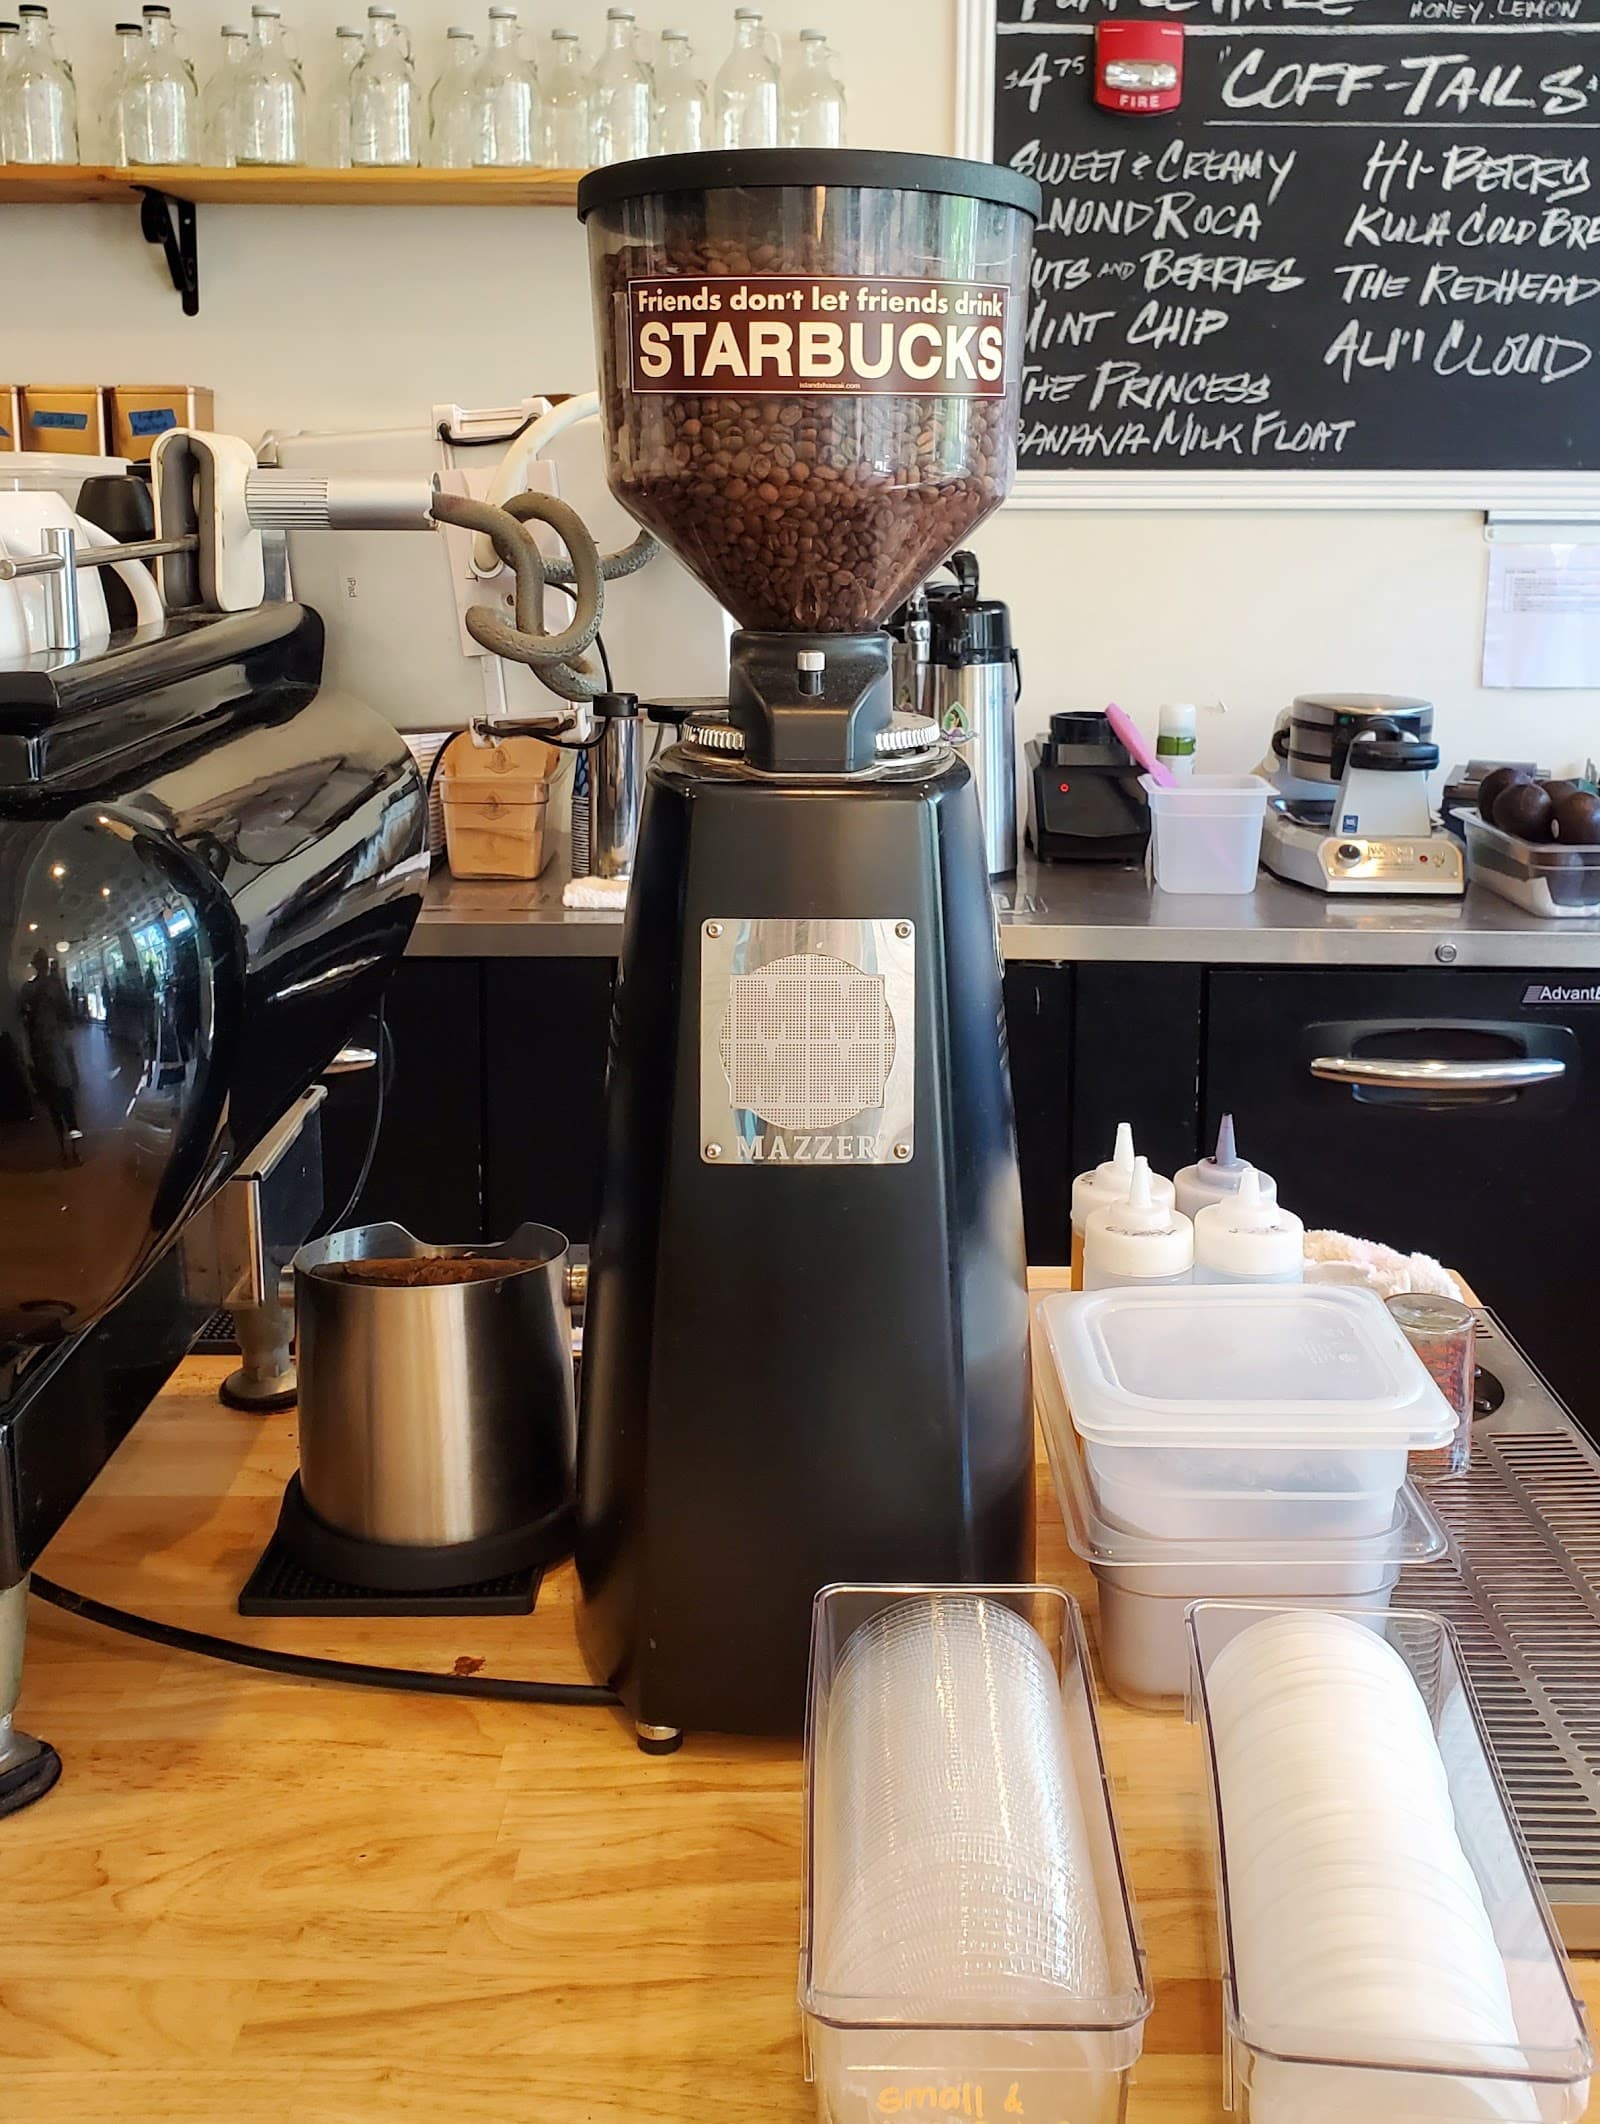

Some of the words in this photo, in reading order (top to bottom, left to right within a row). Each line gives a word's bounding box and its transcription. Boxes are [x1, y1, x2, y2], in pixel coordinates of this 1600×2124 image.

[1499, 0, 1582, 18] LEMON
[1119, 94, 1160, 108] FIRE
[1009, 139, 1127, 185] SWEET
[1131, 151, 1153, 181] &
[1156, 139, 1297, 206] CREAMY
[1035, 196, 1155, 237] MOND
[1152, 191, 1262, 242] ROCA
[1344, 203, 1452, 247] KULA
[1456, 202, 1538, 246] COLD
[1031, 247, 1092, 300] UTS
[1097, 262, 1137, 281] AND
[1139, 247, 1305, 294] BERRIES
[1334, 263, 1411, 304] THE
[1419, 262, 1600, 307] REDHEAD
[638, 288, 722, 313] Friends
[729, 286, 803, 312] don't
[811, 286, 851, 312] let
[856, 287, 949, 315] friends
[954, 289, 1003, 318] drink
[1126, 299, 1230, 350] CHIP
[639, 321, 1003, 382] STARBUCKS
[1433, 319, 1593, 384] CLOUD
[1088, 359, 1272, 412] PRINCESS
[1152, 408, 1245, 457] MILK
[1251, 409, 1357, 456] FLOAT
[736, 1135, 879, 1161] MAZZER
[877, 2082, 984, 2119] small
